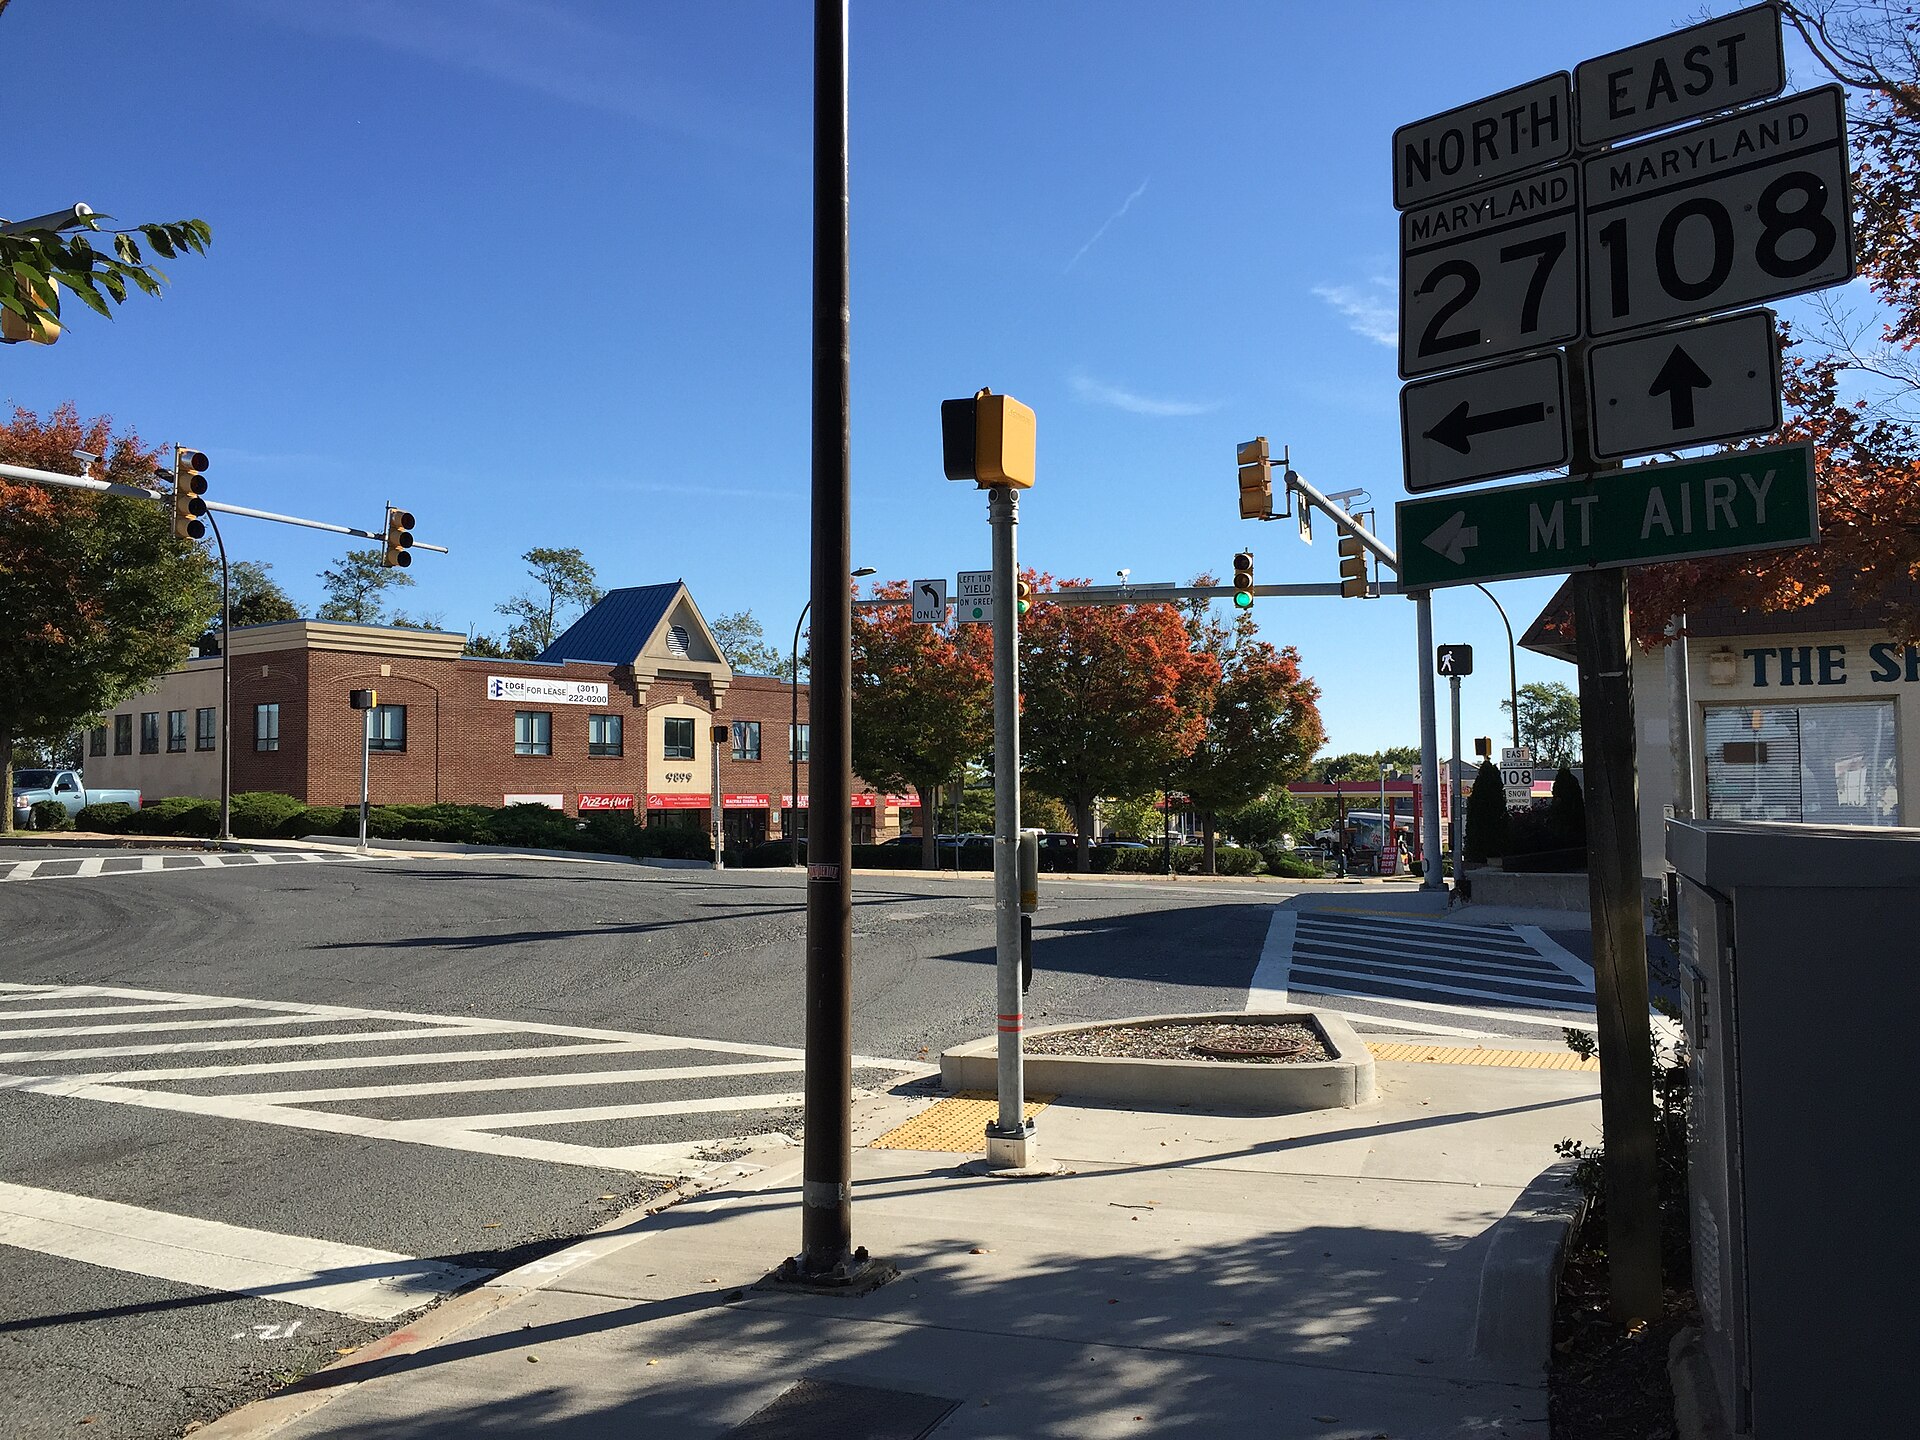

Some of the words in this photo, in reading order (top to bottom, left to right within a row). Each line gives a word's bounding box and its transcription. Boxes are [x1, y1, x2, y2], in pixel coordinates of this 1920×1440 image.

[1607, 33, 1746, 121] EAST
[1405, 94, 1560, 189] NORTH
[1610, 112, 1810, 193] MARYLAND
[1411, 177, 1569, 243] MARYLAND
[1599, 170, 1837, 319] 108
[1414, 231, 1567, 359] 27
[1529, 495, 1599, 554] MT
[1640, 469, 1777, 540] AIRY
[959, 575, 975, 584] LEFT
[978, 574, 992, 583] TUR
[964, 584, 991, 593] YIELD
[959, 598, 970, 607] ON
[916, 610, 942, 620] ONLY
[1743, 645, 1848, 687] THE
[505, 682, 525, 691] EDGE
[526, 686, 542, 695] FOR
[543, 687, 567, 696] LEASE
[577, 684, 599, 694] (301)
[568, 694, 607, 704] 222-0200
[1506, 750, 1525, 759] EAST
[665, 772, 693, 783] 9899
[1502, 770, 1532, 785] 108
[1508, 790, 1528, 798] SNOW
[580, 795, 610, 808] Pizza
